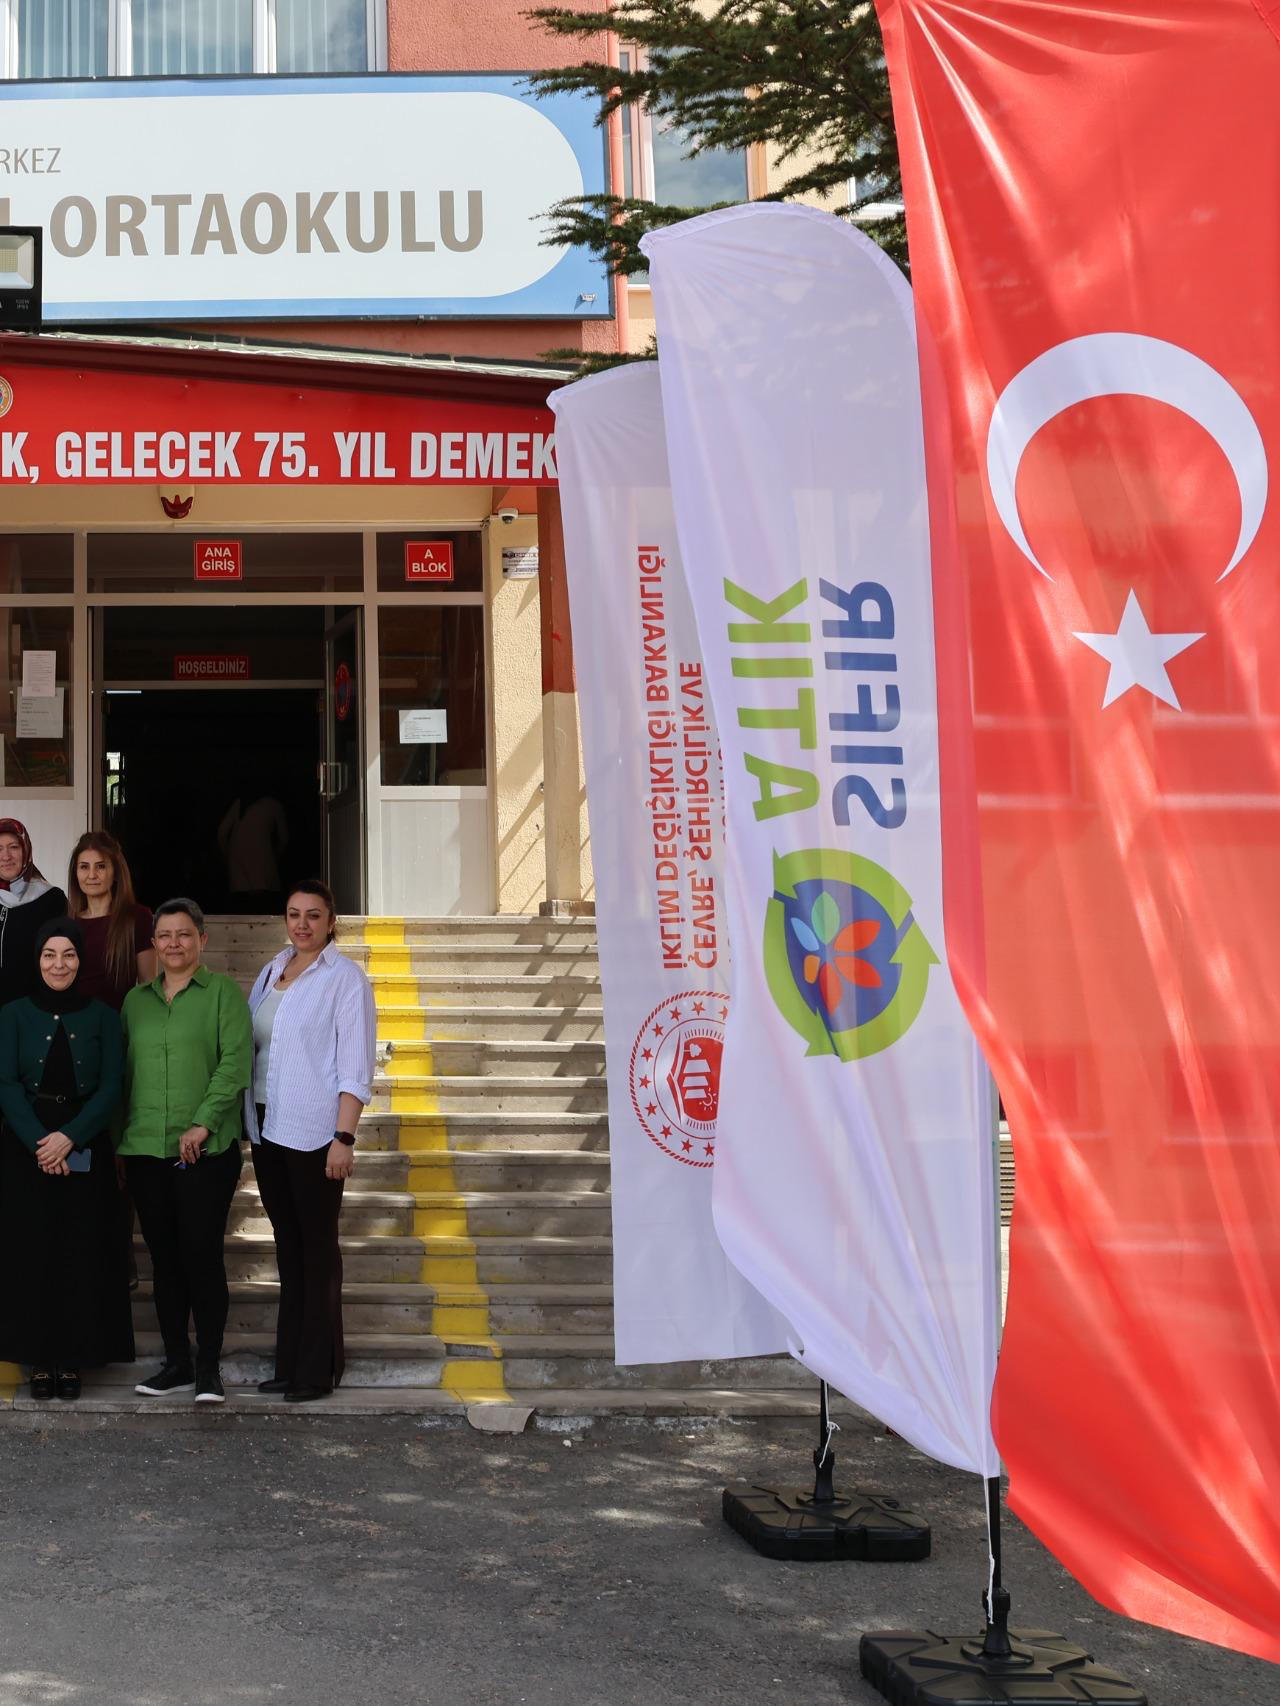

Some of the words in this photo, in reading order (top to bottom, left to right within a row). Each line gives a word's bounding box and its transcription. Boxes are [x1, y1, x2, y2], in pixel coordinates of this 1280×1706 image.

[49, 190, 484, 258] ORTAOKULU
[55, 431, 242, 478] GELECEK
[254, 431, 319, 478] 75.
[333, 431, 395, 478] YIL
[410, 432, 559, 479] DEMEK
[204, 546, 232, 557] ANA
[424, 548, 434, 559] A
[201, 558, 236, 573] GİRİŞ
[412, 562, 447, 573] BLOK
[178, 657, 246, 677] HOŞGELDİNİZ
